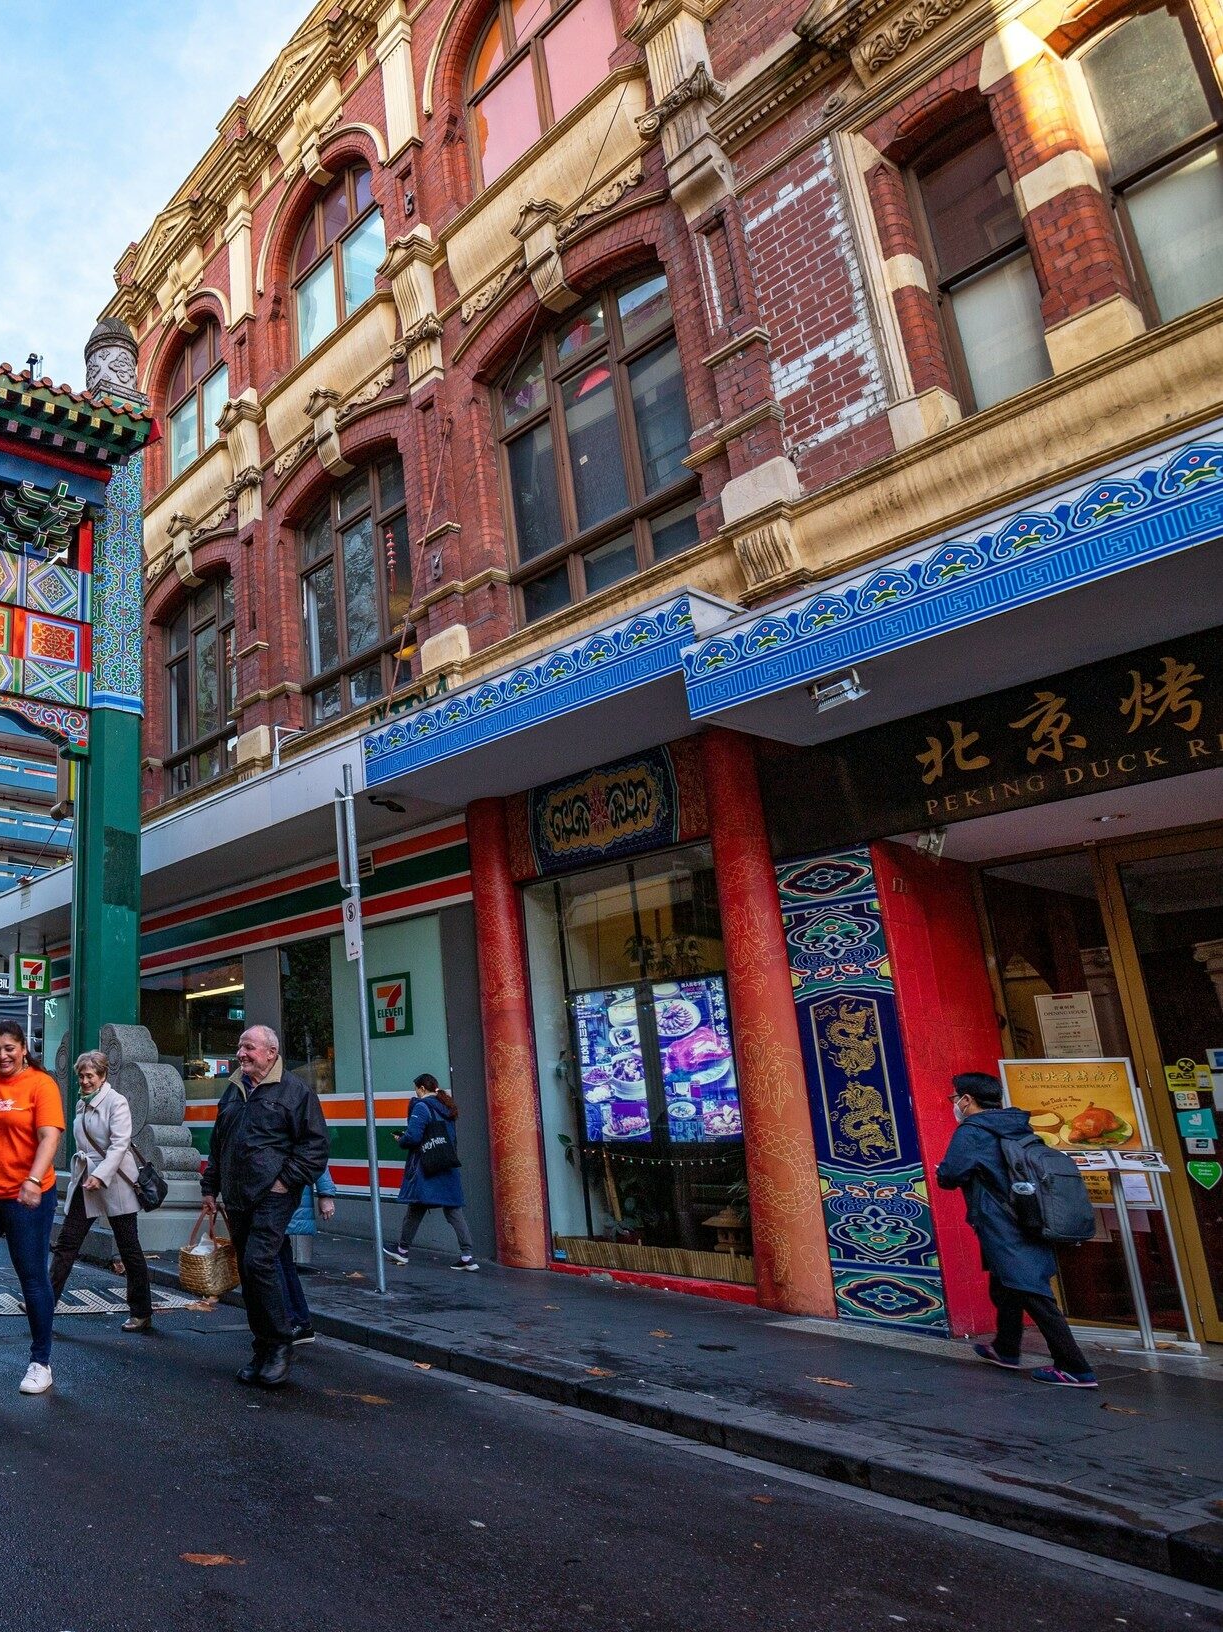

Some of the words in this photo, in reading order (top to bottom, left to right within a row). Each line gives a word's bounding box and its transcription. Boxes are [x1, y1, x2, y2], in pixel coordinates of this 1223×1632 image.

[926, 774, 1045, 816] PEKING
[1062, 748, 1169, 786] DUCK
[23, 961, 43, 990] 7
[376, 983, 402, 1032] 7
